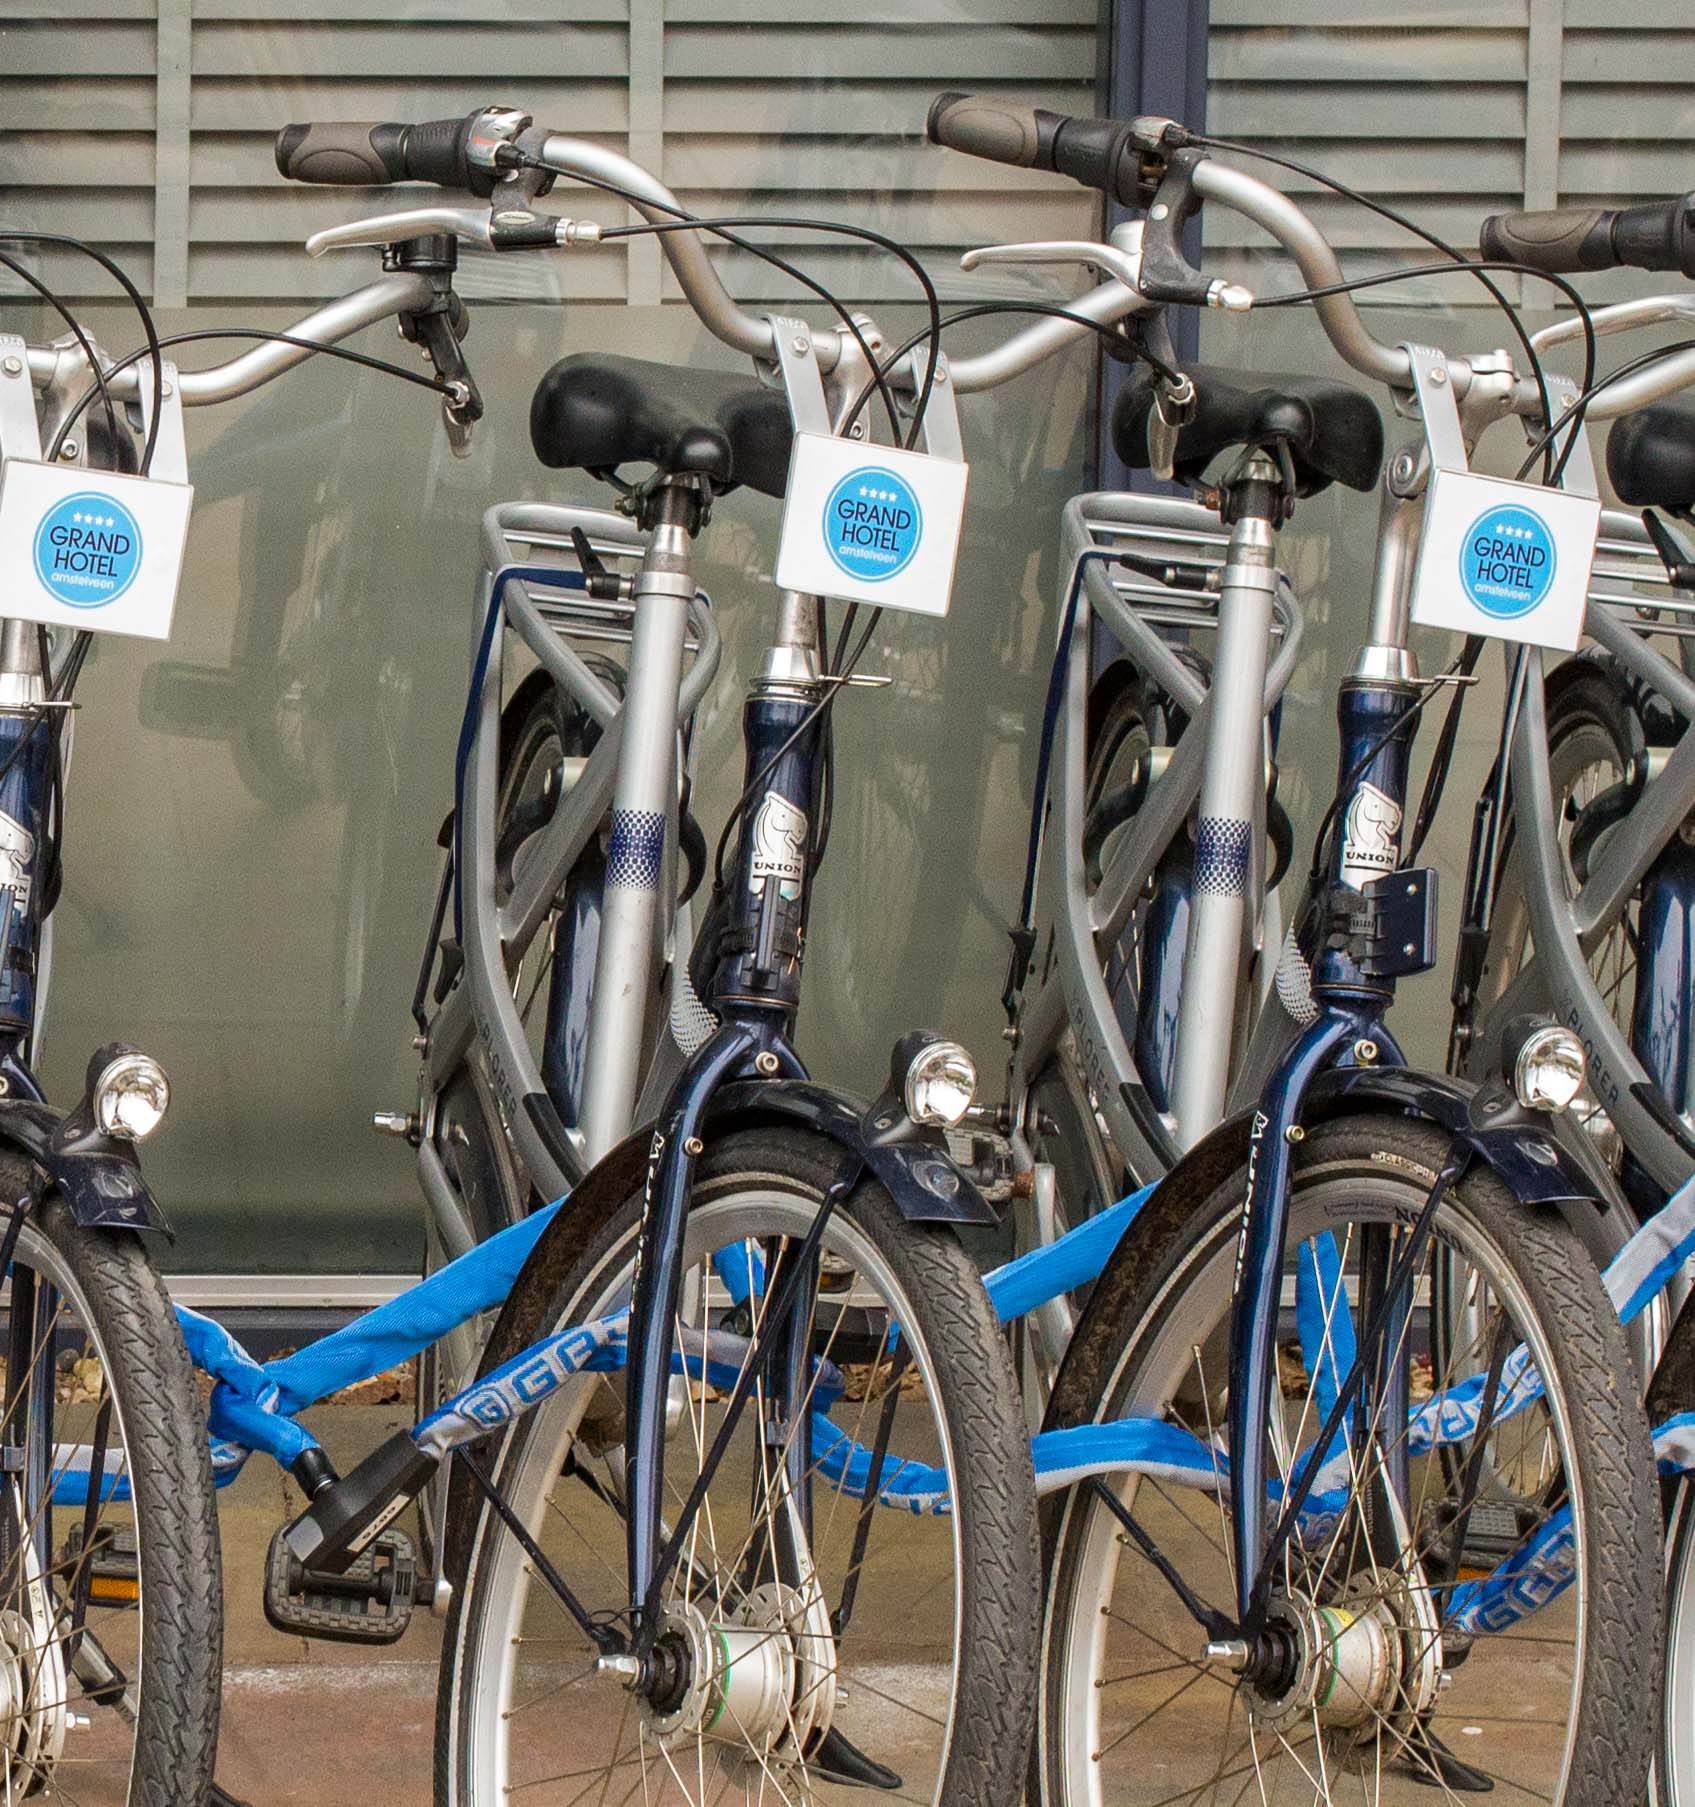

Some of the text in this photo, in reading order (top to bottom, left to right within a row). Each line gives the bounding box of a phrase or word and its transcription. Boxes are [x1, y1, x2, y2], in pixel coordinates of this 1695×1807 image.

[837, 499, 912, 530] GRAND
[50, 525, 131, 556] GRAND
[841, 522, 900, 552] HOTEL
[54, 548, 118, 577] HOTEL
[838, 544, 898, 565] amstelveen
[1474, 536, 1546, 568] GRAND
[51, 571, 116, 591] amstelveen
[1476, 559, 1534, 589] HOTEL
[1473, 582, 1532, 602] amstelveen
[754, 861, 802, 875] UNION
[1345, 850, 1396, 865] UNION
